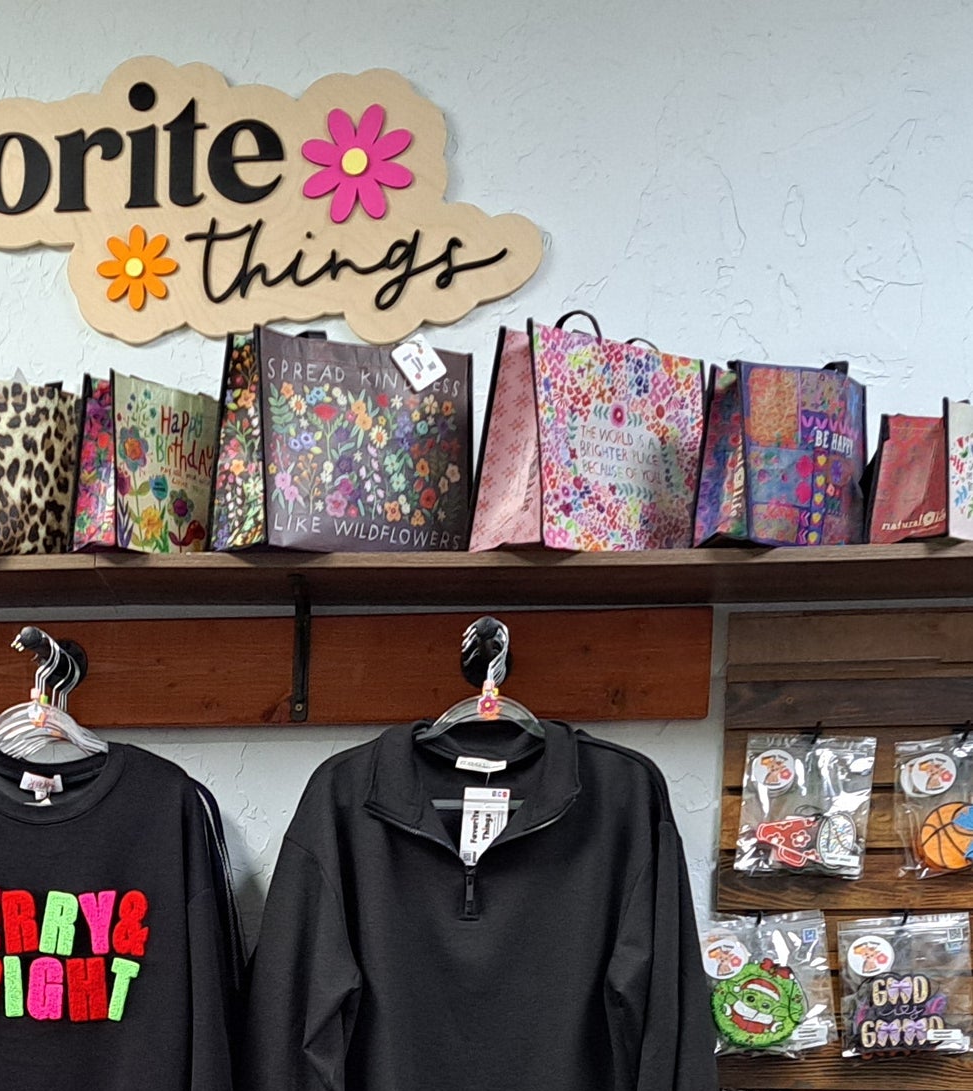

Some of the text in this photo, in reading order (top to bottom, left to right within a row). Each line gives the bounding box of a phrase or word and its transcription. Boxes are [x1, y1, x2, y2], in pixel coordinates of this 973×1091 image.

[185, 217, 508, 311] things
[267, 357, 461, 398] SPREAD KINESS
[581, 424, 596, 439] THE
[599, 428, 633, 446] WORLD
[815, 429, 854, 458] BE HAPPY
[580, 439, 628, 462] BRIGHTER
[582, 458, 625, 478] BECAUSE
[273, 513, 462, 550] LIKE WILDFLOWERS
[881, 514, 922, 530] natural
